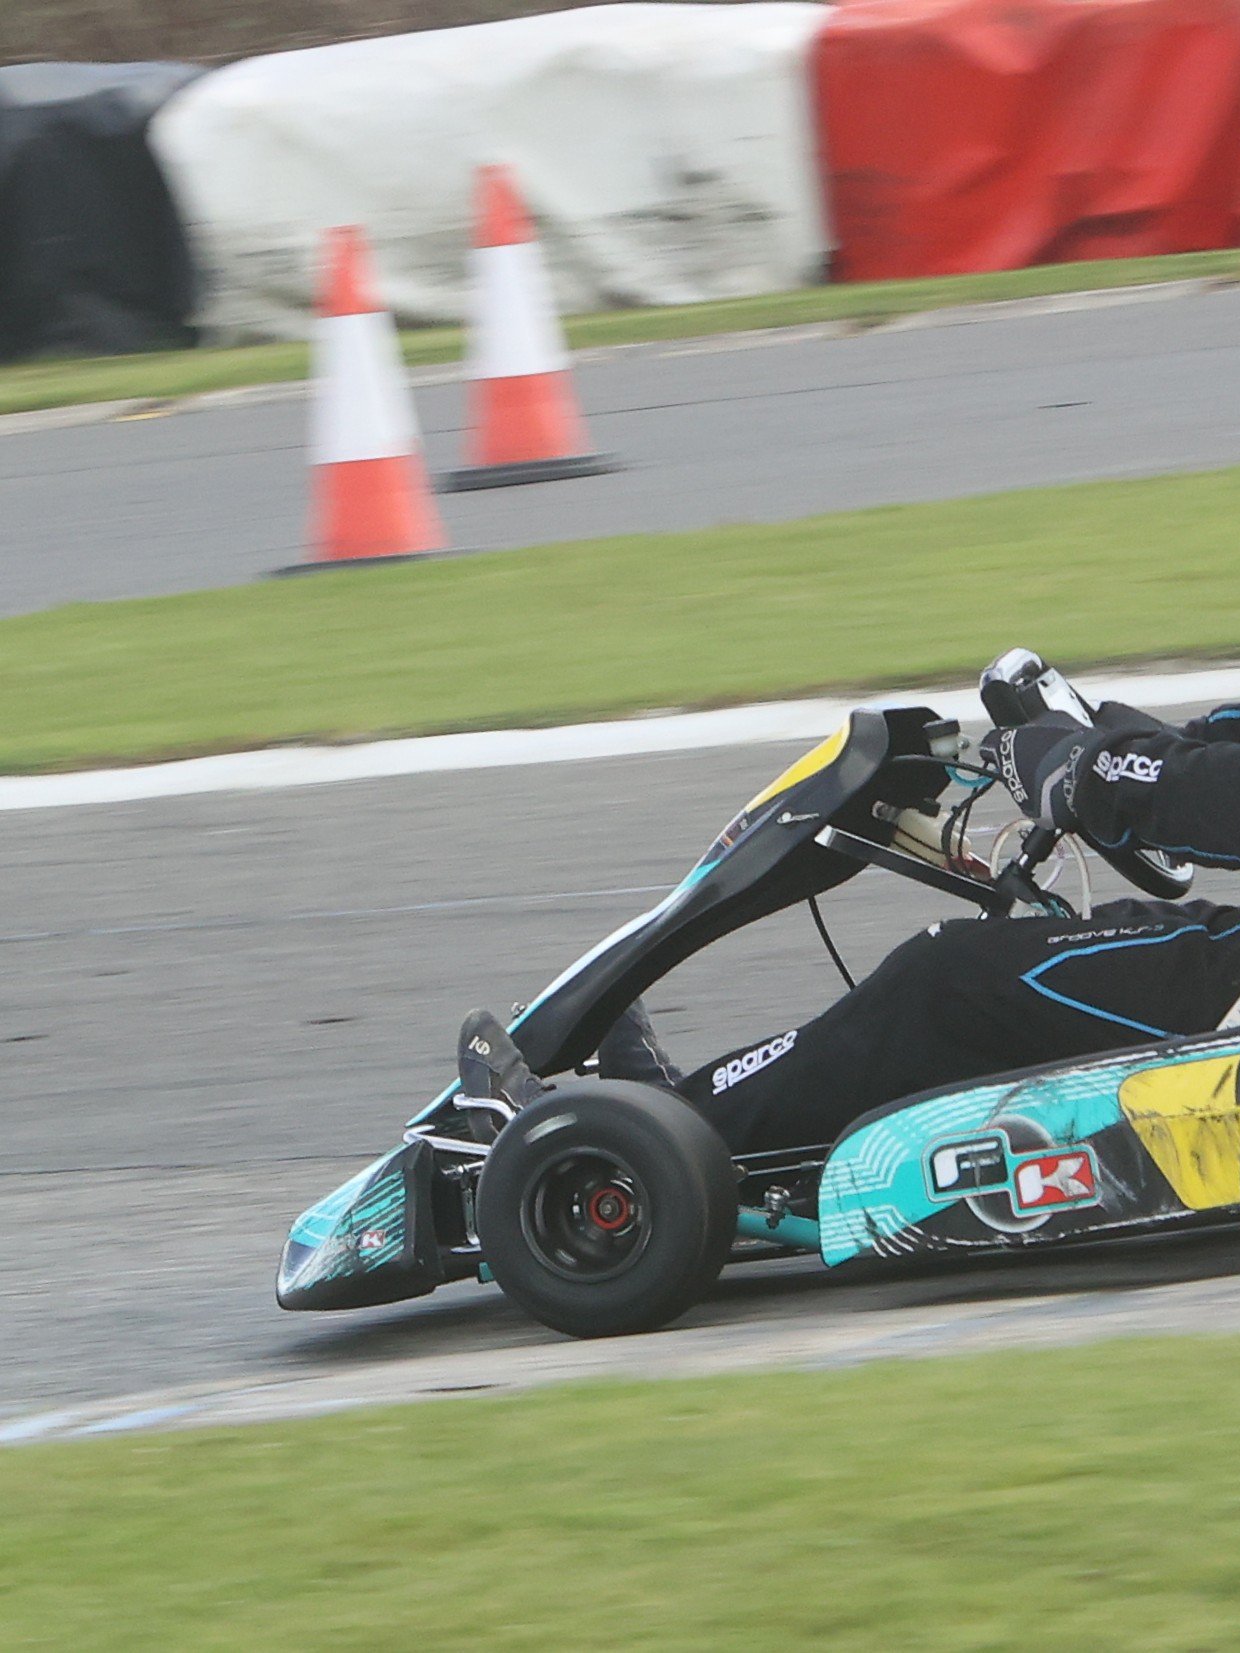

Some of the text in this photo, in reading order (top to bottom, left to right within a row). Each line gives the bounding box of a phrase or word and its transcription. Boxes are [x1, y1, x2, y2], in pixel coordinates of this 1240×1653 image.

[1000, 730, 1028, 803] sparco
[1093, 750, 1163, 782] sprco
[712, 1030, 798, 1095] sparco
